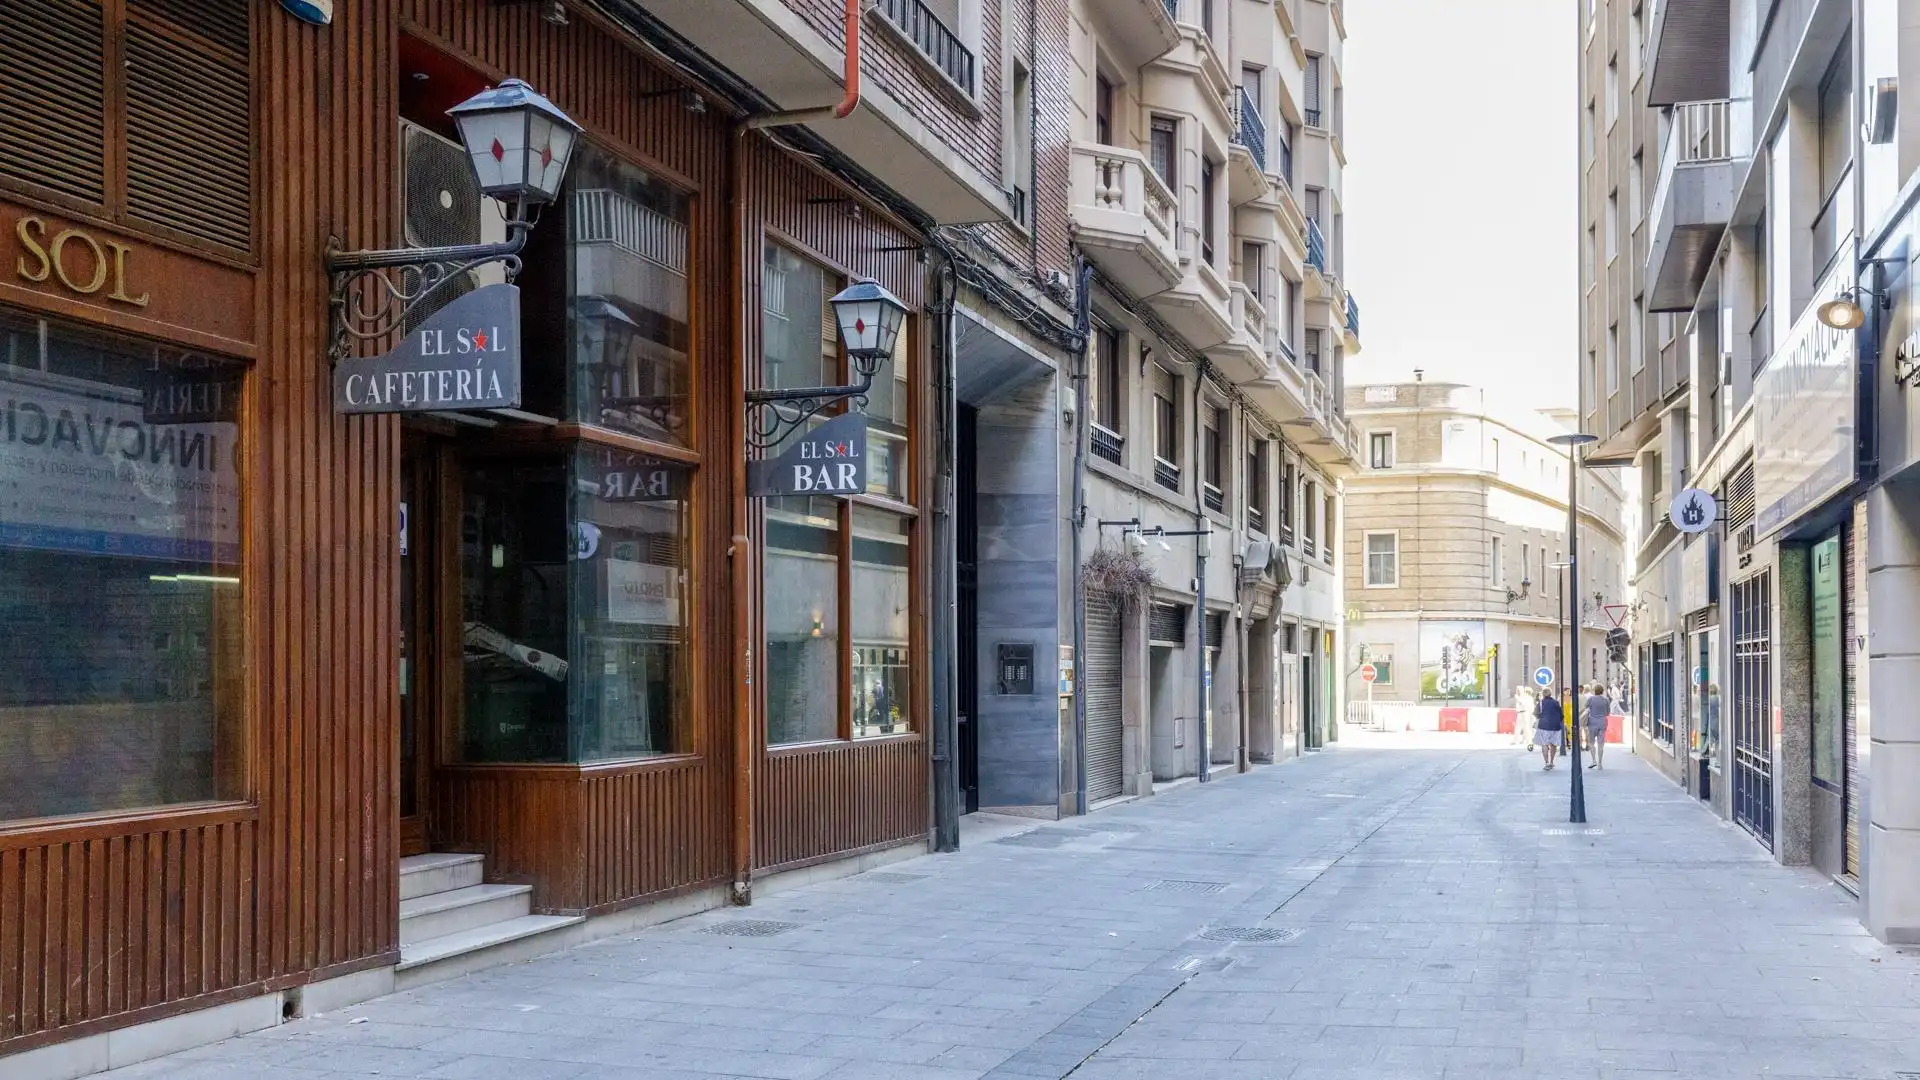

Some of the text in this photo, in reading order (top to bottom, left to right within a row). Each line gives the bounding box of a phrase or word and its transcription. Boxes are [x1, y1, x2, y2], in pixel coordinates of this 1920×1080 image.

[16, 216, 150, 307] SOL
[420, 329, 451, 356] EL
[345, 358, 504, 406] CAFETERÍA
[801, 441, 821, 459] EL
[793, 463, 858, 491] BAR
